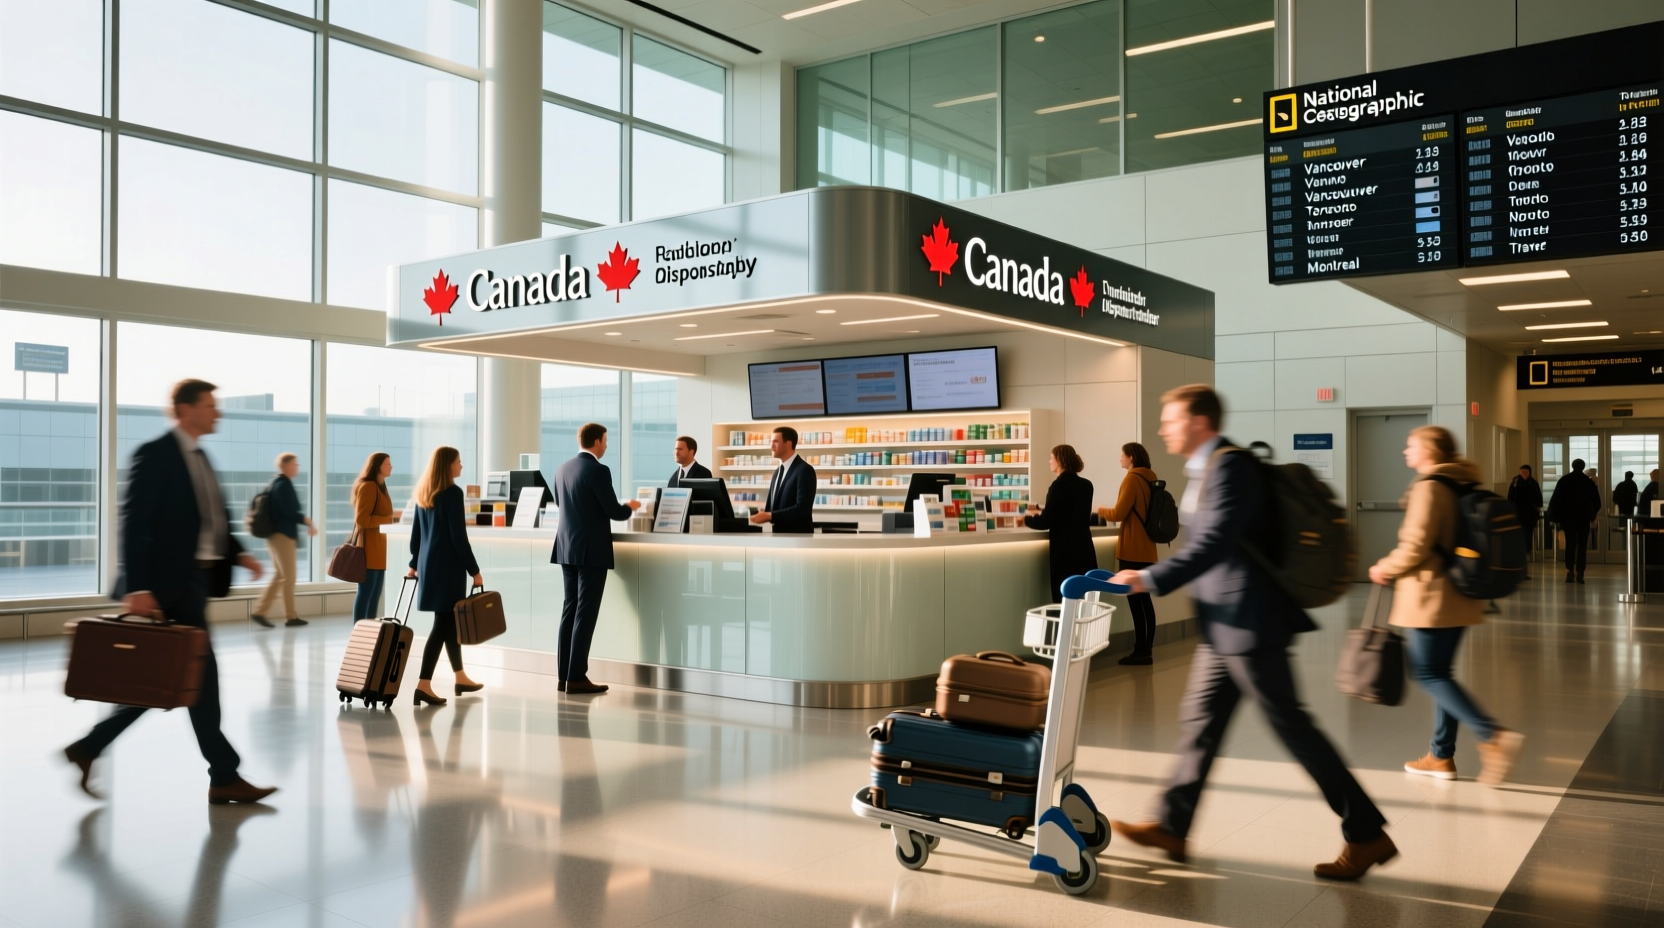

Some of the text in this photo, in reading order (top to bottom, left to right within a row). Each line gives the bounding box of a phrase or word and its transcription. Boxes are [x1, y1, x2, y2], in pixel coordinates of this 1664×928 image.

[1303, 80, 1377, 107] National
[466, 254, 590, 312] Canada
[964, 237, 1065, 305] Canada
